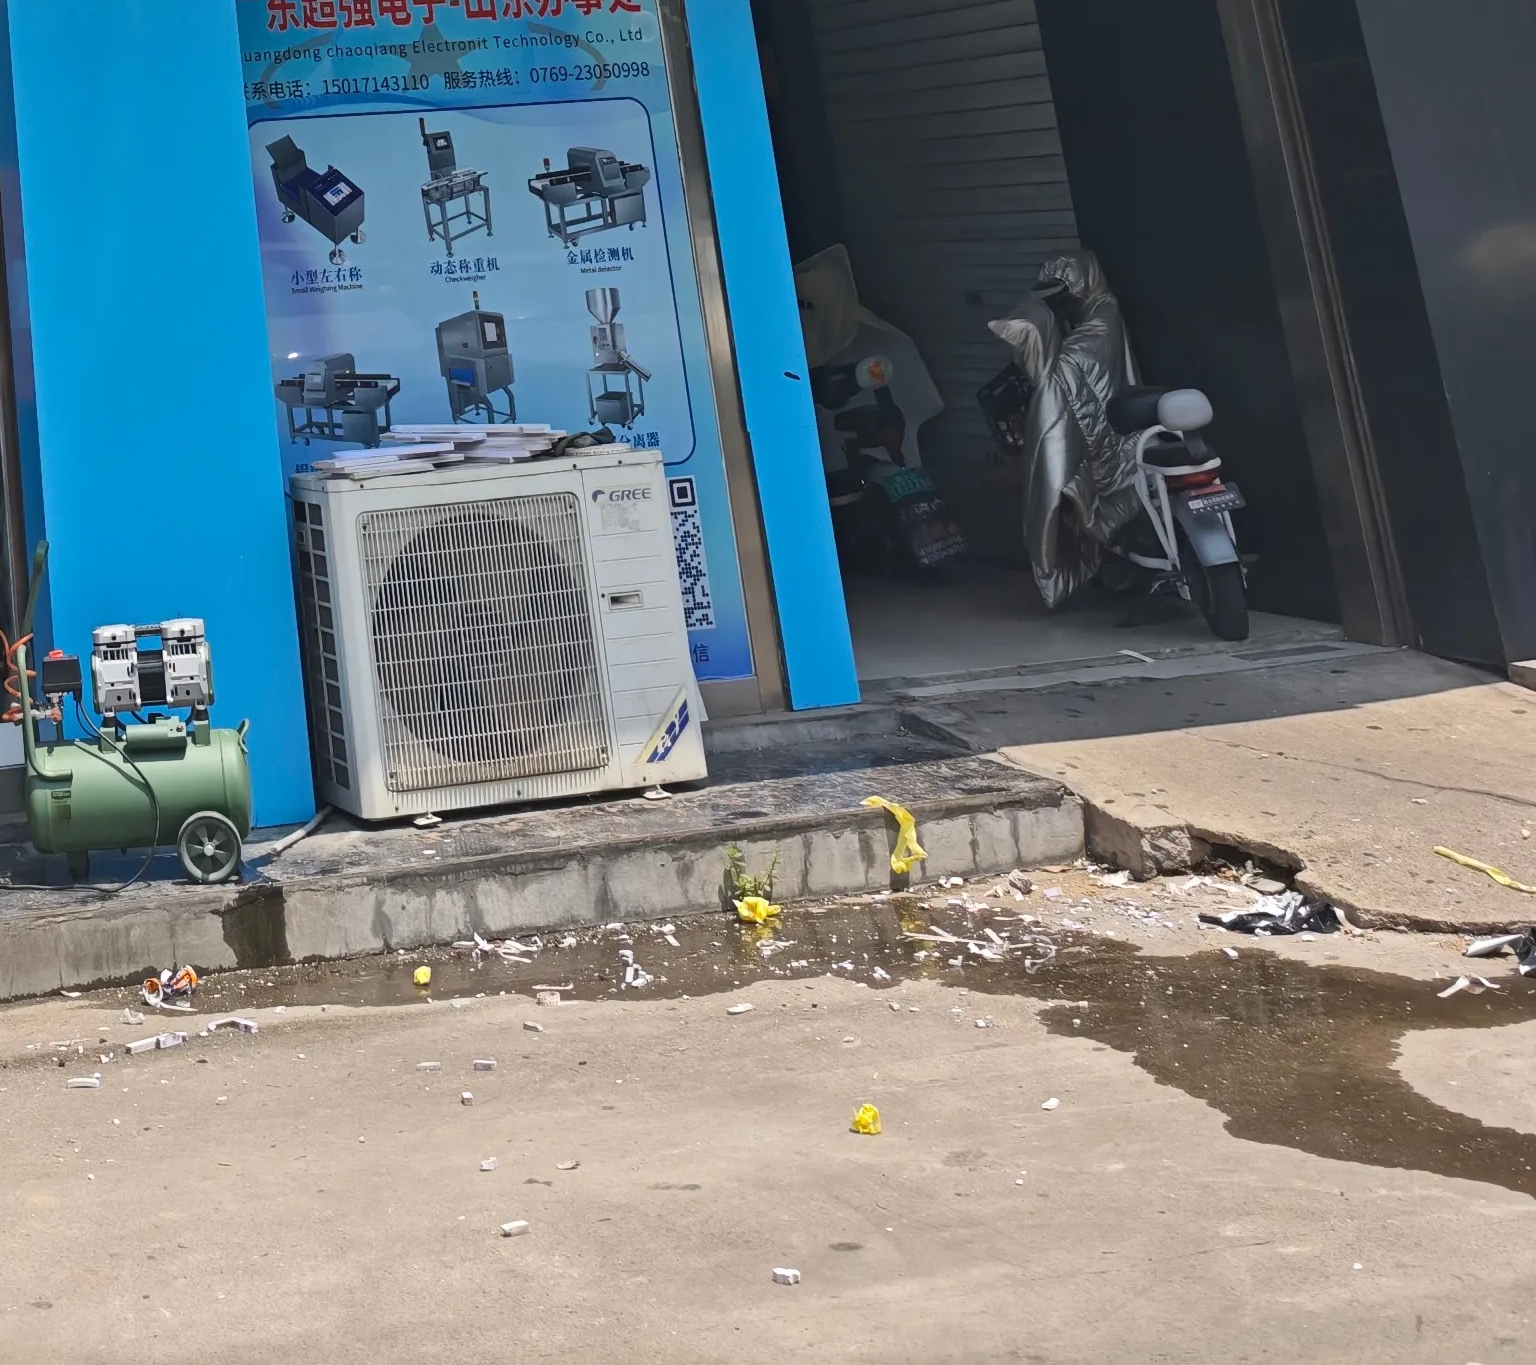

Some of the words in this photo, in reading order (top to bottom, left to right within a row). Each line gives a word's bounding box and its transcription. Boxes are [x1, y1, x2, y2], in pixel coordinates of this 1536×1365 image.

[327, 42, 408, 60] chaoqiang
[494, 31, 580, 50] Technology
[586, 30, 614, 46] Co.,
[619, 26, 643, 42] Ltd
[323, 72, 430, 95] 15017143110
[530, 60, 651, 84] 0769-23050998
[429, 256, 500, 276] 动态称重机
[567, 246, 635, 266] 金属检测机
[291, 267, 363, 287] 小型左右称
[608, 487, 653, 502] GREE
